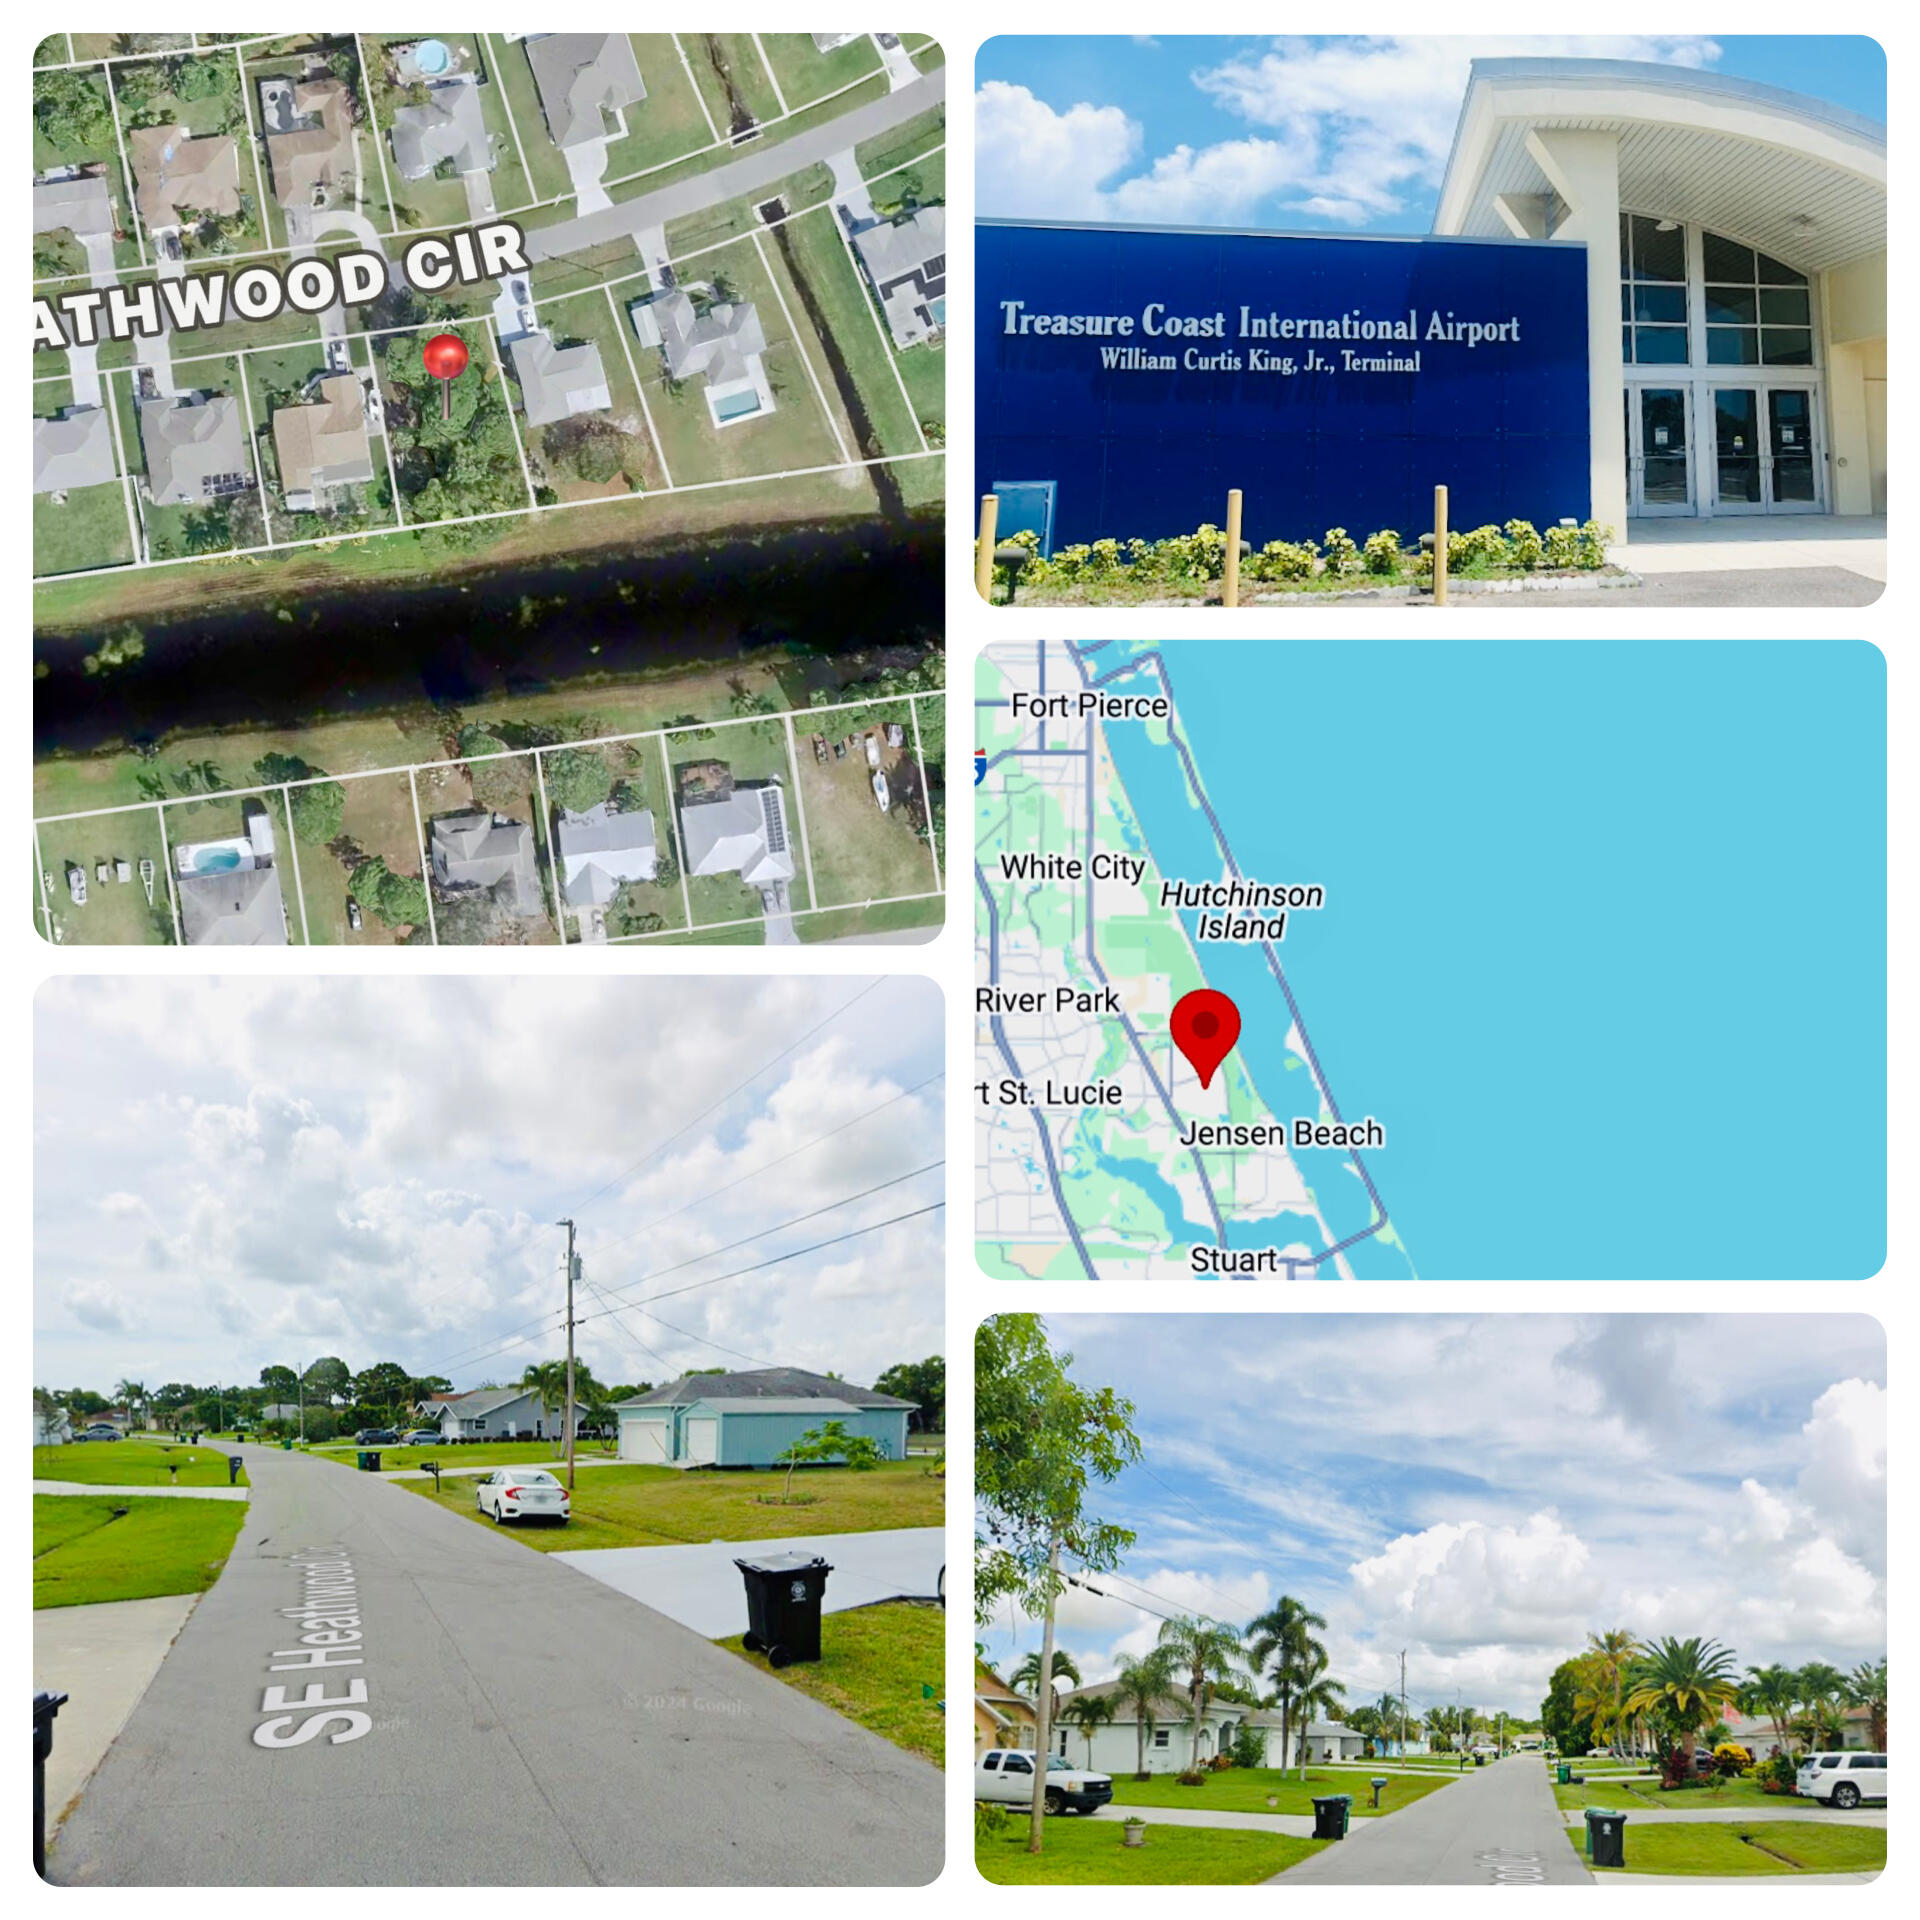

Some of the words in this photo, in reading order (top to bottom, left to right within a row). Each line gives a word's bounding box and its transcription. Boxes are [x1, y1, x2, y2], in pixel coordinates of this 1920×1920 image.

[1000, 300, 1135, 336] Treasure
[1142, 303, 1226, 337] Coast
[1239, 305, 1418, 340] International
[1425, 310, 1521, 347] Airport
[1100, 346, 1178, 371] William
[1184, 348, 1242, 371] Curtis
[1248, 349, 1298, 375] King,
[1303, 349, 1335, 374] Jr.,
[1341, 350, 1421, 372] Terminal
[1011, 692, 1069, 718] Fort
[1079, 692, 1168, 718] Pierce
[1000, 854, 1082, 880] White
[1091, 854, 1147, 885] City
[1160, 881, 1324, 908] Hutchinson
[1198, 913, 1286, 940] Island
[976, 987, 1047, 1012] River
[1056, 986, 1120, 1012] Park
[999, 1079, 1035, 1105] St.
[1047, 1079, 1122, 1105] Lucie
[1179, 1121, 1284, 1147] Jensen
[1294, 1120, 1383, 1146] Beach
[1190, 1247, 1278, 1273] Stuart
